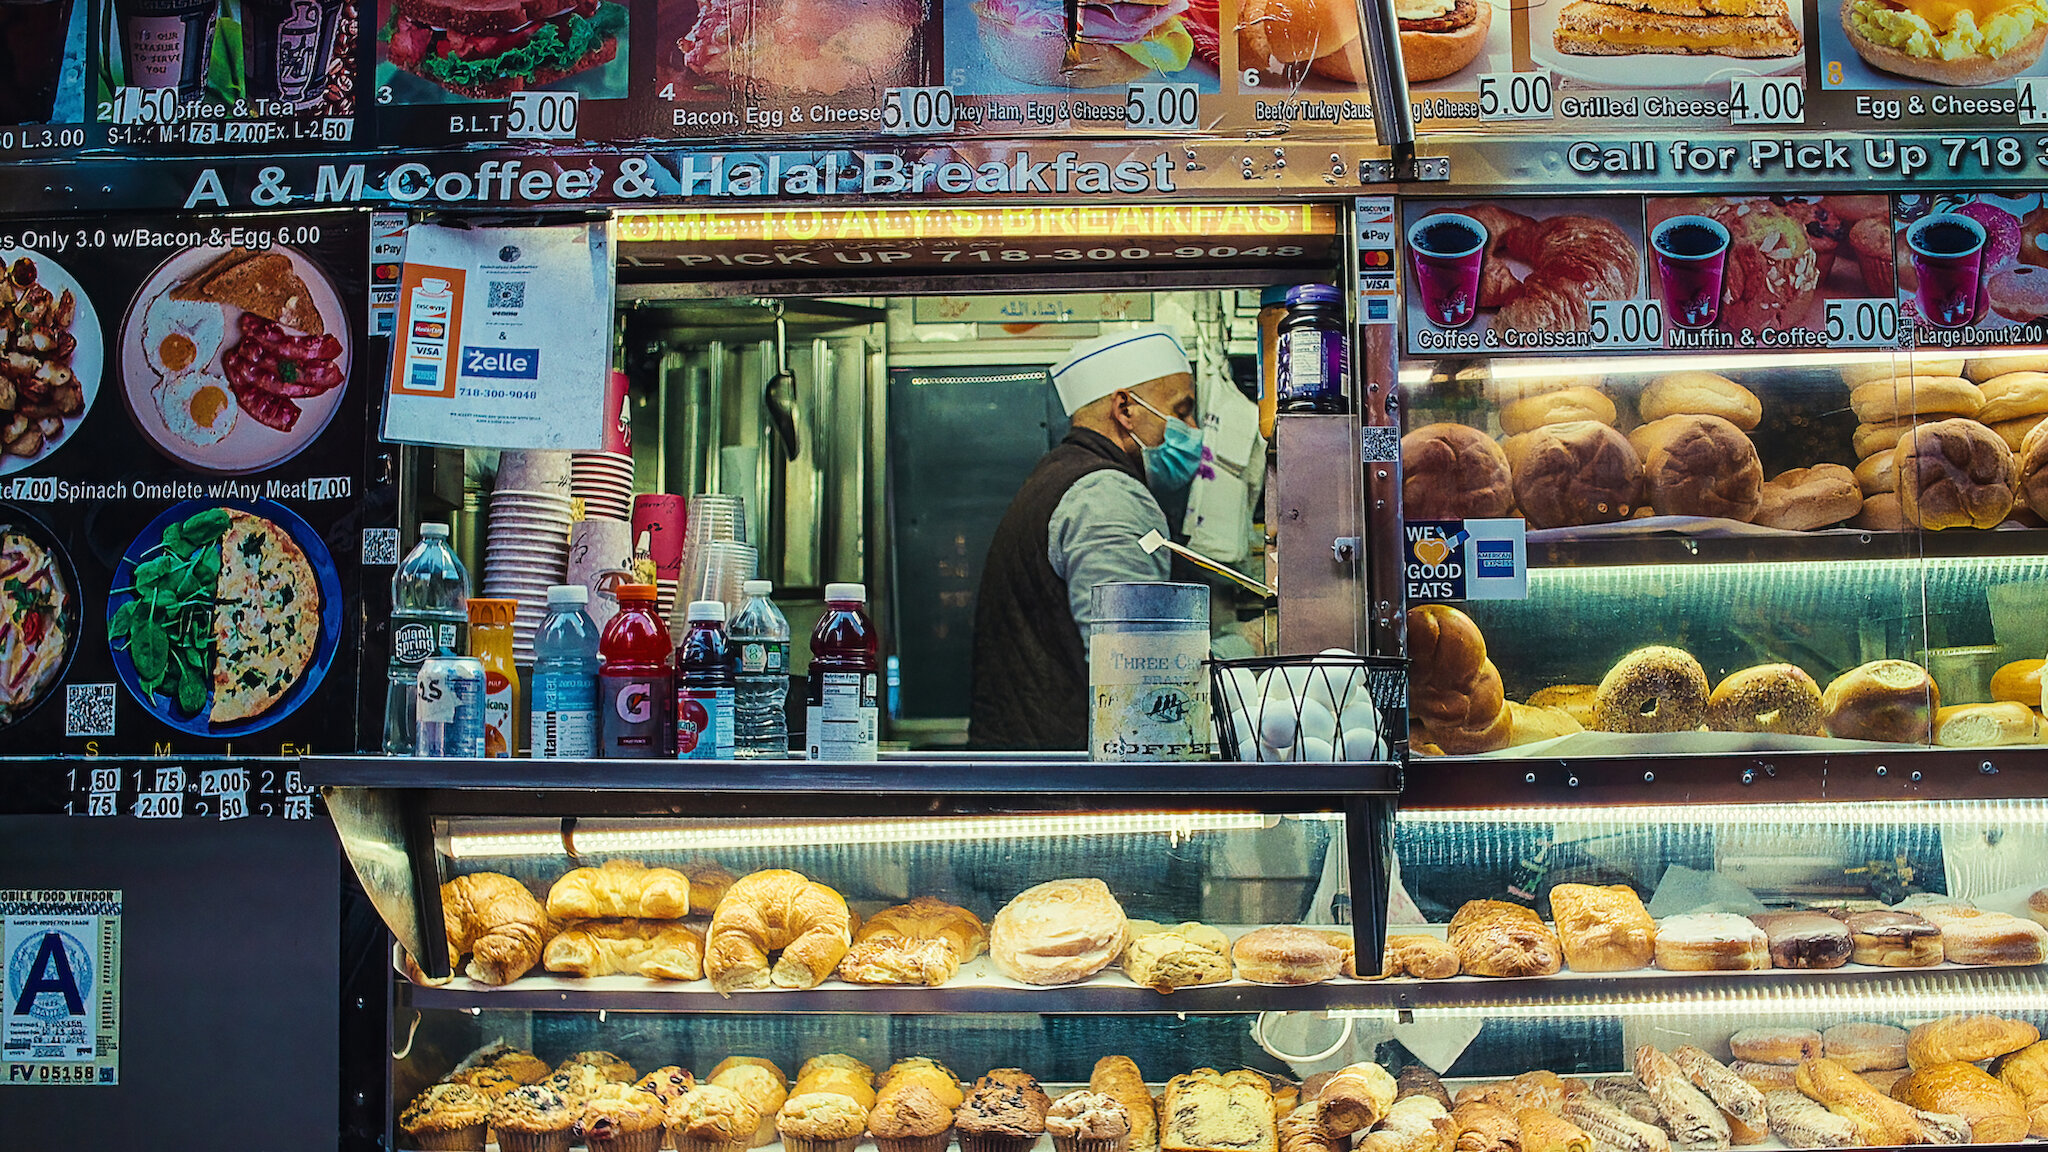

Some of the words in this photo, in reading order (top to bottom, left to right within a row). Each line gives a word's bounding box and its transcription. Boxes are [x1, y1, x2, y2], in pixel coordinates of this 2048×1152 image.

[1243, 68, 1260, 87] 6
[1828, 61, 1843, 85] 8
[377, 85, 394, 105] 3
[659, 83, 676, 101] 4
[1480, 76, 1550, 115] 5.00
[1732, 82, 1802, 119] 4.00
[97, 102, 112, 120] 2
[114, 88, 177, 125] 1.50
[177, 101, 225, 119] offee
[232, 98, 248, 118] &
[255, 98, 294, 117] Tea
[508, 96, 577, 132] 5.00
[673, 107, 740, 127] Bacon,
[746, 106, 784, 129] Egg
[789, 105, 804, 123] &
[809, 103, 881, 123] Cheese
[882, 90, 952, 128] 5.00
[954, 107, 983, 125] rkey
[987, 103, 1024, 123] Ham,
[1027, 102, 1054, 123] Egg
[1058, 101, 1070, 120] &
[1072, 100, 1126, 121] Cheese
[1126, 87, 1197, 125] 5.00
[1256, 101, 1283, 121] Beef
[1285, 105, 1299, 120] or
[1300, 101, 1341, 122] Turkey
[1343, 101, 1374, 121] Saus
[1423, 101, 1433, 119] &
[1435, 100, 1479, 119] Cheese
[1561, 96, 1637, 117] Grilled
[1644, 96, 1730, 117] Cheese
[1856, 96, 1902, 119] Egg
[1908, 95, 1925, 115] &
[1932, 95, 2016, 114] Cheese
[450, 115, 502, 133] B.L.T
[22, 129, 84, 149] L.3.00
[1568, 142, 1655, 172] Call
[1670, 141, 1736, 170] for
[1751, 139, 1850, 170] Pick
[1865, 139, 1928, 175] Up
[1941, 137, 2022, 167] 718
[183, 169, 229, 209] A
[251, 166, 292, 207] &
[314, 164, 366, 203] M
[388, 161, 592, 201] Coffee
[613, 157, 658, 198] &
[681, 153, 838, 197] Halal
[863, 151, 1176, 194] Breakfast
[1360, 205, 1391, 213] DISCOVER
[374, 220, 404, 228] DISCOVER
[622, 210, 736, 241] OME
[1001, 204, 1312, 234] BREAKFAST
[22, 230, 69, 253] Only
[76, 230, 105, 248] 3.0
[112, 228, 201, 248] w/Bacon
[209, 227, 224, 246] &
[230, 227, 271, 250] Egg
[278, 226, 320, 245] 6.00
[1371, 230, 1390, 242] Pay
[383, 244, 402, 255] Pay
[676, 251, 821, 266] PICK
[833, 249, 913, 264] UP
[931, 246, 1304, 263] 718-300-9048
[1366, 280, 1390, 290] VISA
[416, 303, 445, 312] DISCOVER
[1591, 304, 1661, 343] 5.00
[1826, 303, 1896, 342] 5.00
[499, 331, 507, 340] &
[1418, 330, 1479, 347] Coffee
[1484, 329, 1499, 346] &
[1669, 329, 1733, 347] Muffin
[1740, 328, 1756, 345] &
[1761, 327, 1828, 346] Coffee
[1919, 325, 1961, 347] Large
[1965, 326, 2010, 343] Donut
[2013, 325, 2042, 342] 2.00
[417, 347, 439, 356] VISA
[467, 350, 528, 372] Zelle
[459, 387, 537, 400] 718-300-9048
[15, 480, 51, 500] 7.00
[58, 481, 127, 503] Spinach
[132, 480, 203, 500] Omelete
[208, 480, 260, 503] w/Any
[266, 478, 306, 498] Meat
[312, 478, 351, 497] 7.00
[1406, 526, 1435, 541] WE
[1478, 552, 1512, 560] AMERICAN
[1407, 564, 1462, 579] GOOD
[1408, 582, 1453, 598] EATS
[395, 625, 434, 645] Poland
[395, 639, 435, 658] Spring
[1112, 653, 1169, 670] THREE
[487, 699, 509, 711] icana
[616, 683, 651, 724] G
[85, 741, 99, 757] S
[154, 742, 171, 757] M
[205, 771, 241, 793] 2.00
[0, 891, 33, 902] OBILE
[37, 891, 66, 902] FOOD
[70, 891, 113, 902] VENDOR
[14, 933, 86, 1016] A
[10, 1064, 35, 1081] FV
[40, 1066, 95, 1082] 05158
